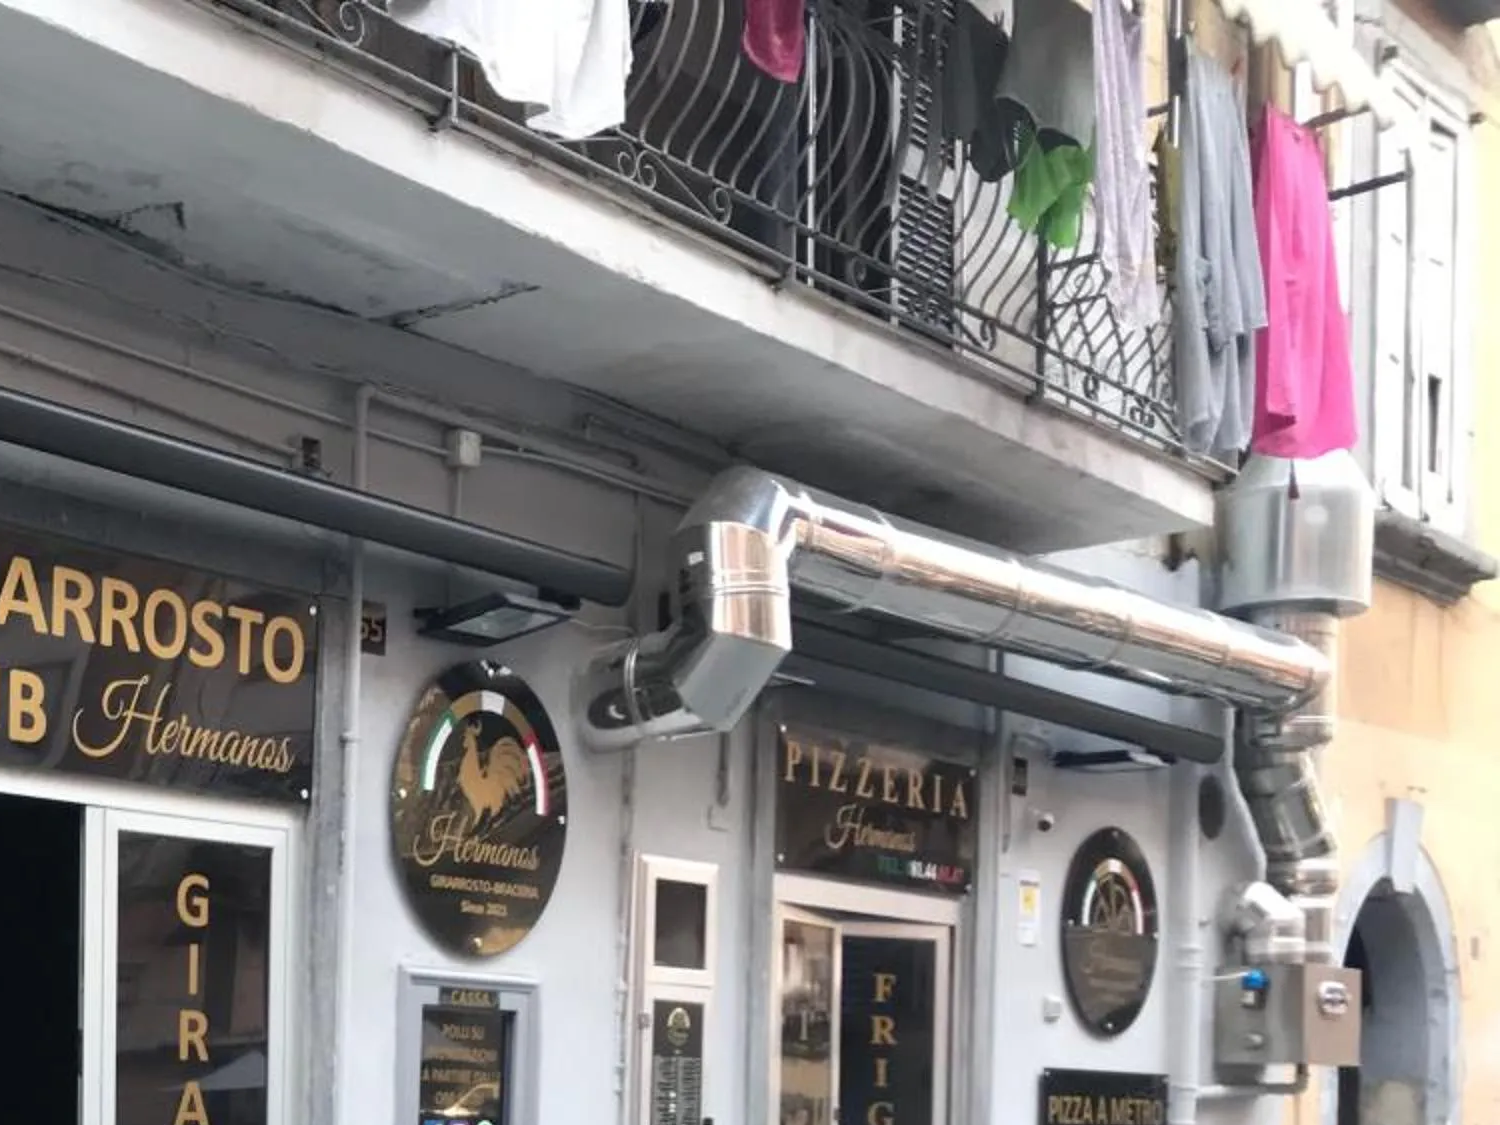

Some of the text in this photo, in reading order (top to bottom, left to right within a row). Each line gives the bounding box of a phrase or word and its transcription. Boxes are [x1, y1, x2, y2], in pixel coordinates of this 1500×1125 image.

[73, 675, 296, 773] Hermanos
[785, 741, 968, 819] PIZZERIA
[413, 811, 540, 871] Hermanos
[1048, 1095, 1093, 1125] PIZZA
[1096, 1096, 1108, 1125] A
